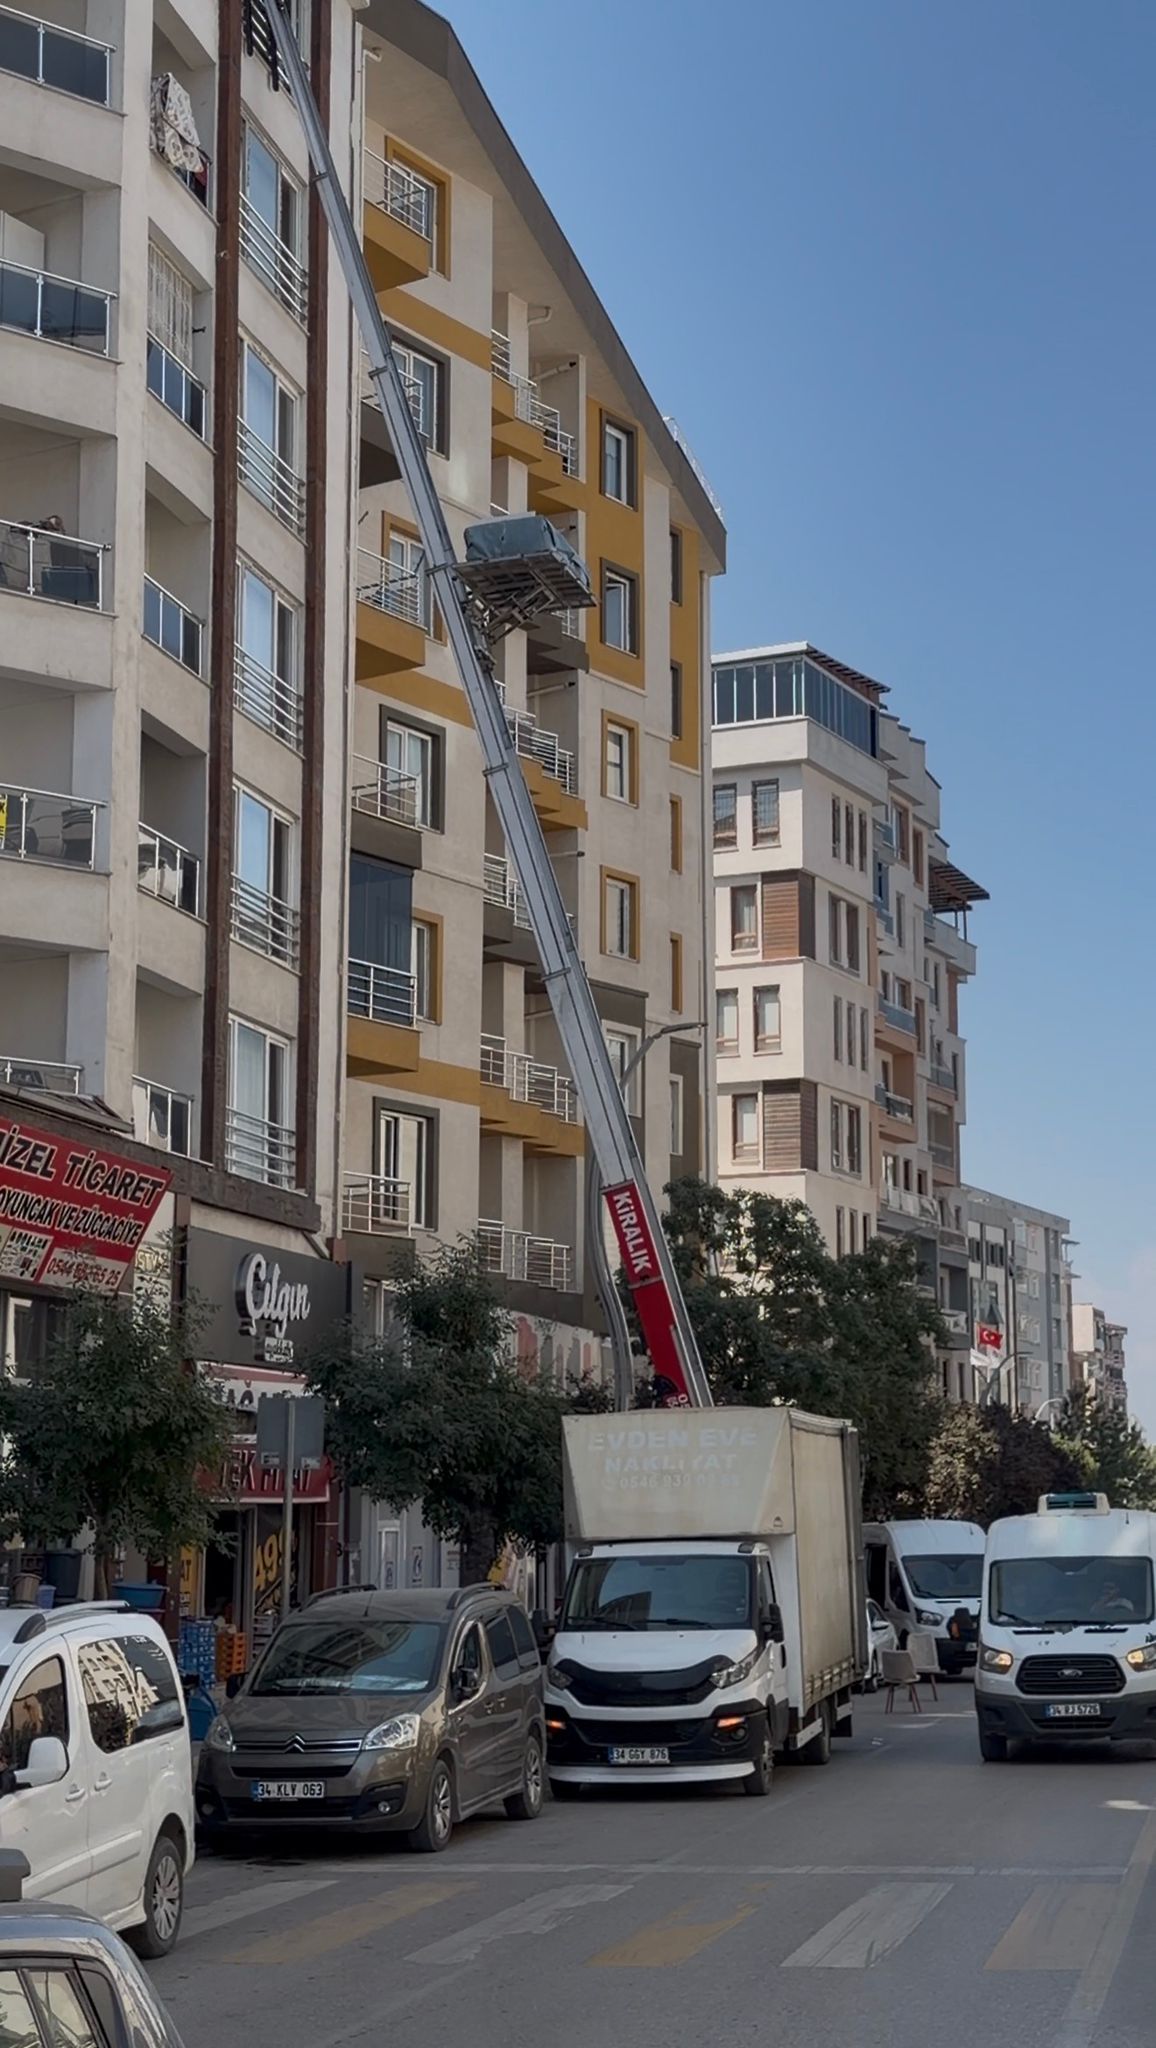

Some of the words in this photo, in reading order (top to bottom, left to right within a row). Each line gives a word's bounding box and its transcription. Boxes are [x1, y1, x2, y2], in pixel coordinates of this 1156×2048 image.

[62, 1150, 167, 1208] TİCARET
[55, 1199, 77, 1234] VE
[71, 1205, 145, 1247] ZÜCCACİYE
[613, 1191, 652, 1274] KİRALIK
[105, 1269, 121, 1286] 25
[588, 1428, 689, 1450] EVDEN
[700, 1427, 758, 1448] EVE
[615, 1748, 626, 1760] 34
[258, 1783, 272, 1797] 34
[302, 1783, 323, 1797] 063
